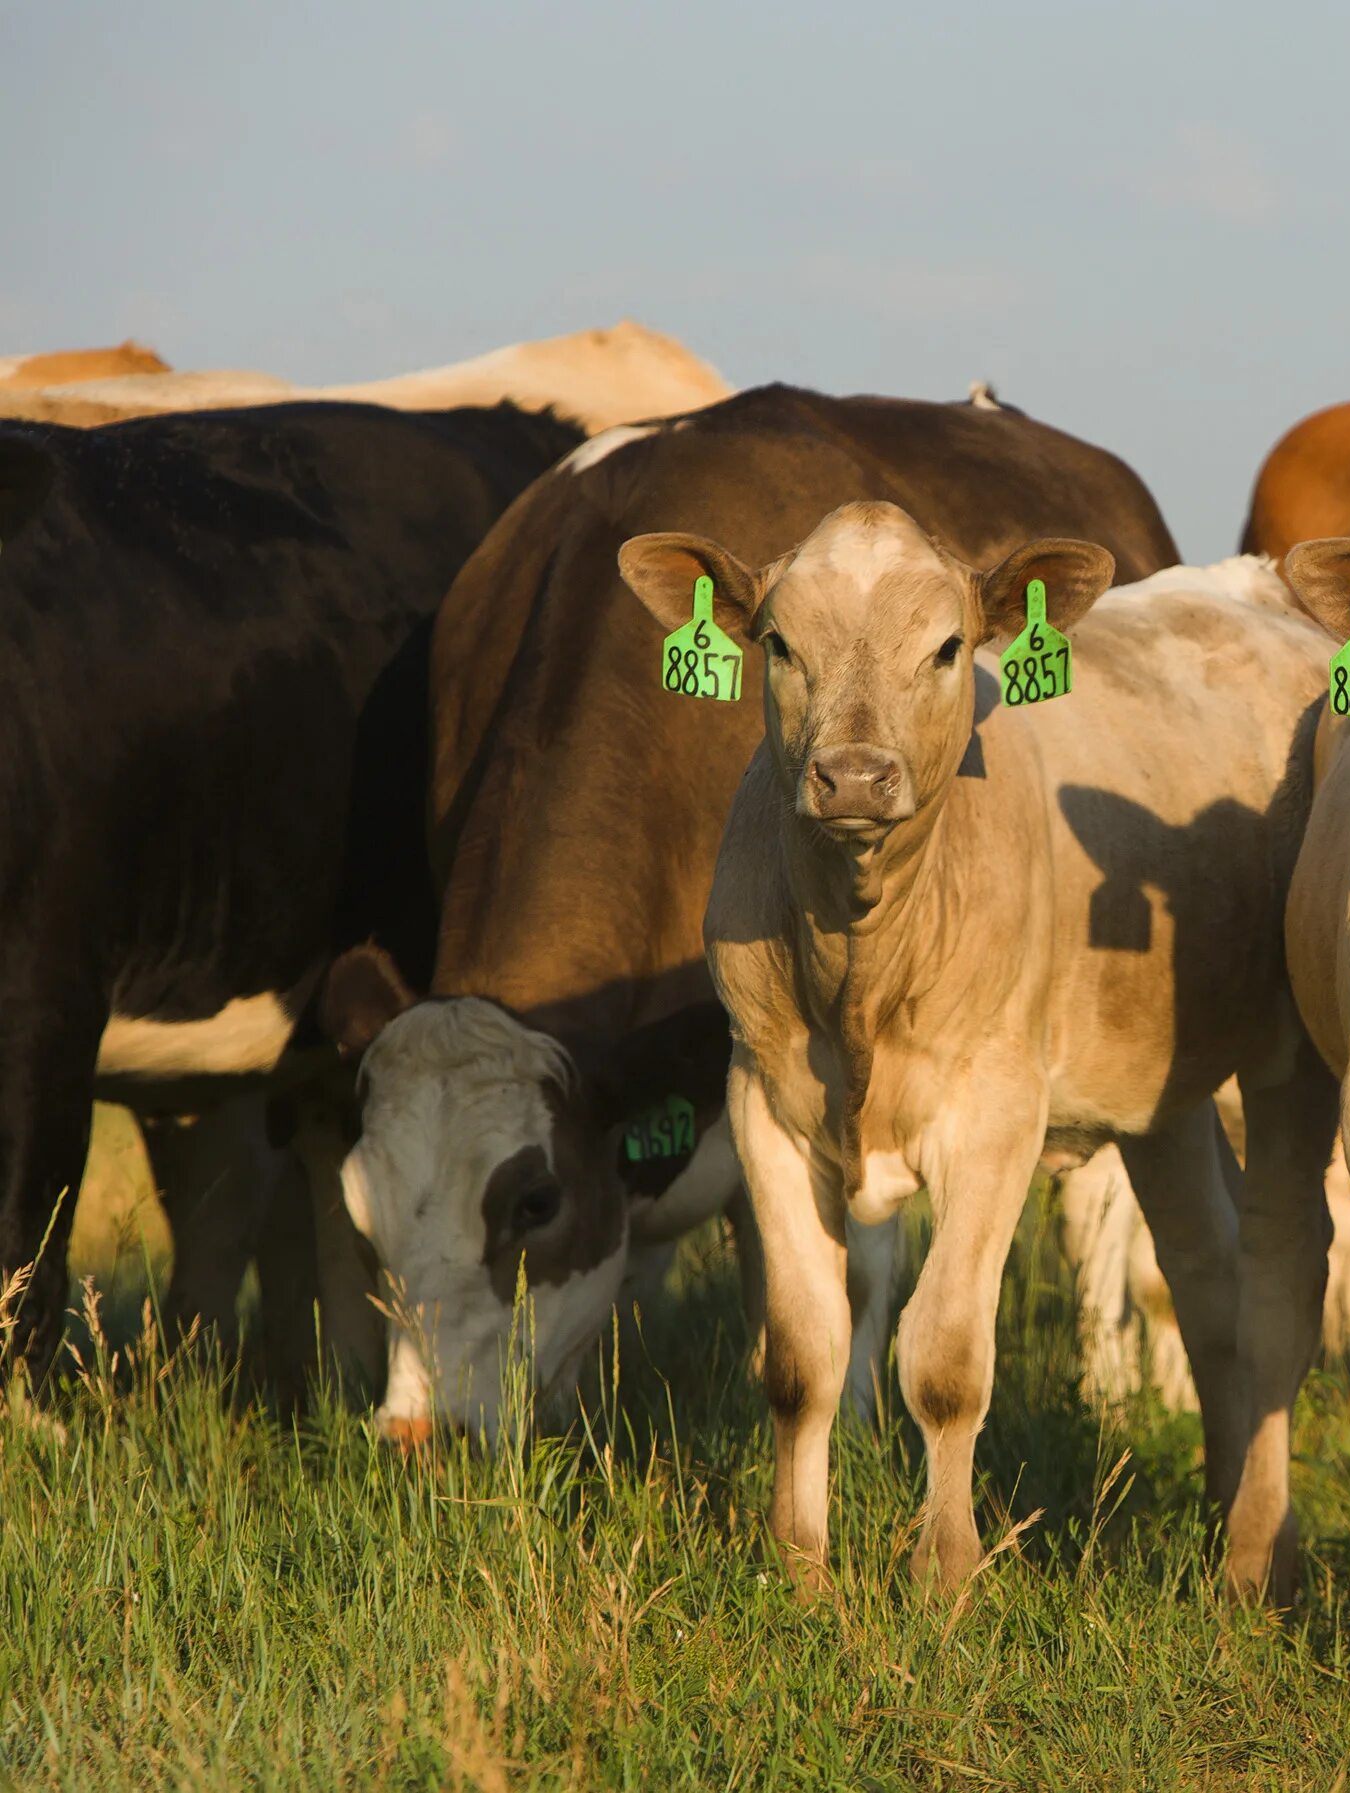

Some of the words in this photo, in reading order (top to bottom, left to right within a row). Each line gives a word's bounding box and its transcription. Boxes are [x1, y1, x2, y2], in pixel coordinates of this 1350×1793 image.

[694, 619, 710, 649] 6
[1030, 623, 1044, 651] 6
[665, 646, 740, 699] 8857
[1004, 647, 1069, 706] 8857
